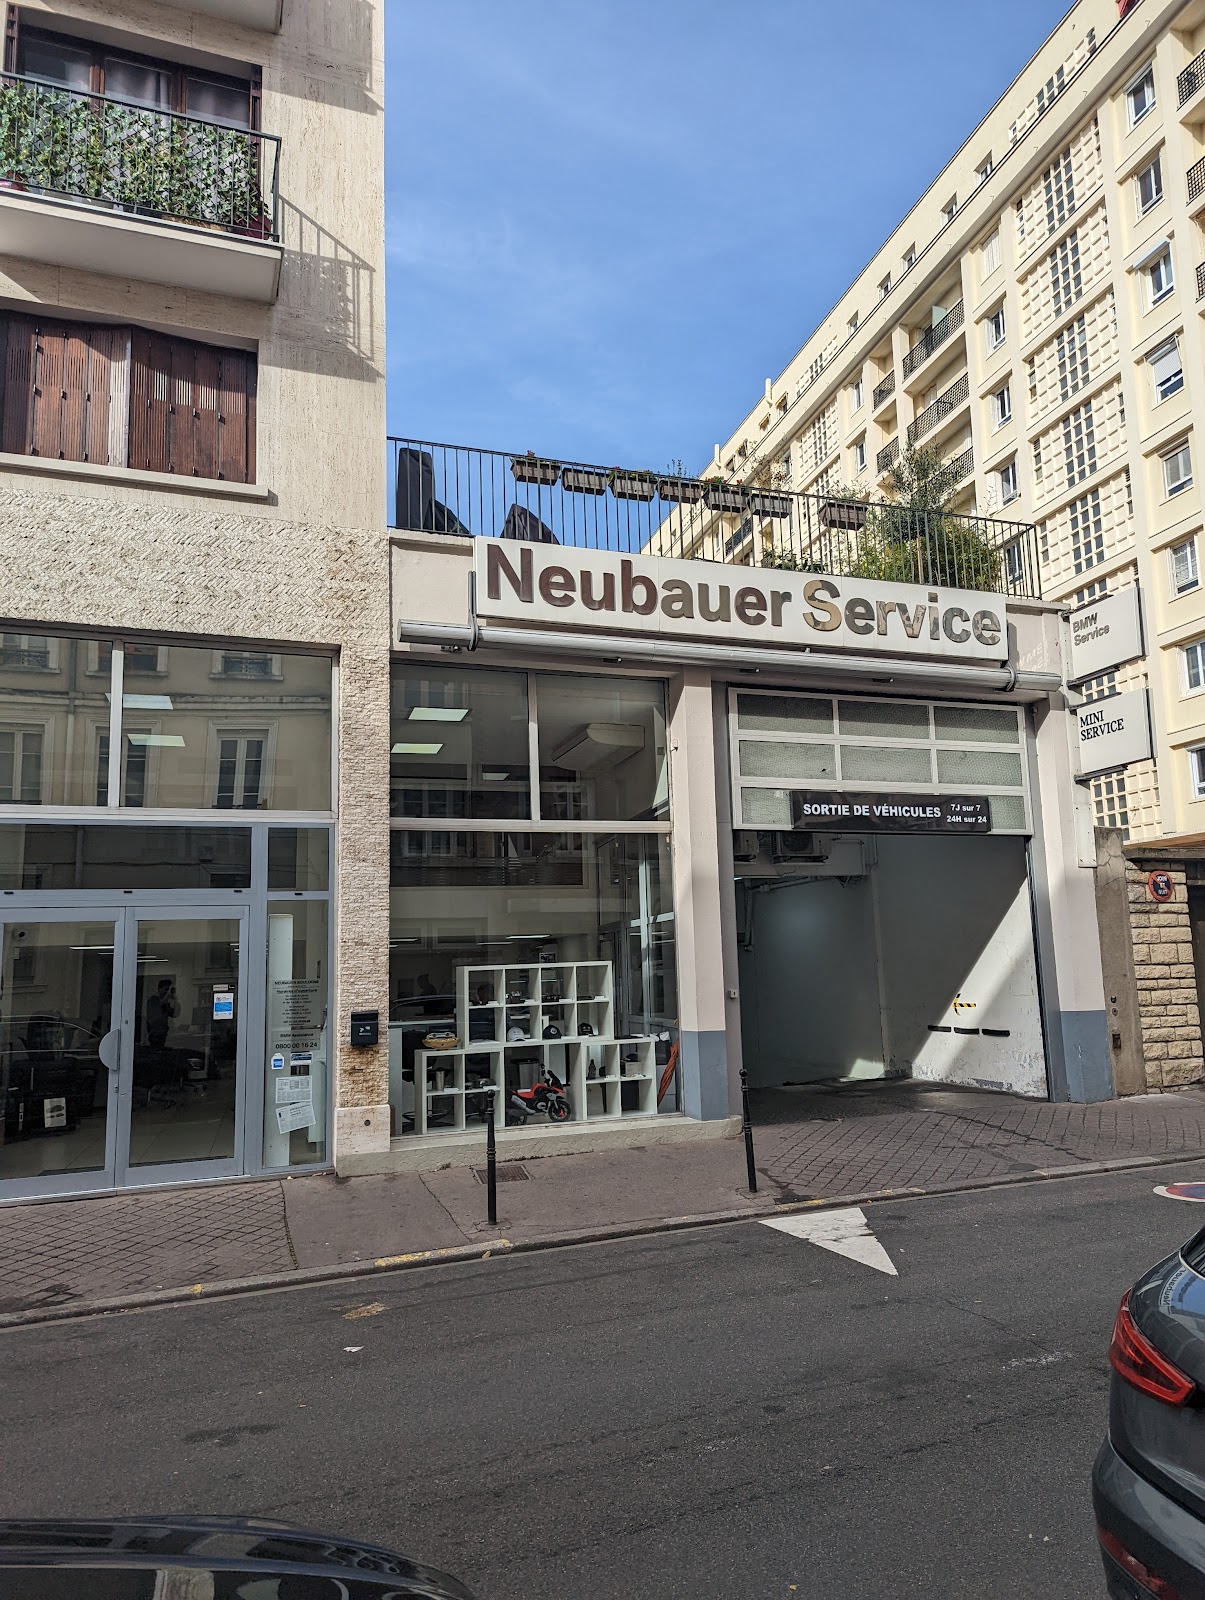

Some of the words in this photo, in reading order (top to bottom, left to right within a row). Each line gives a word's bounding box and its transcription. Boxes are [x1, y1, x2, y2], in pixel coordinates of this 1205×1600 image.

[486, 544, 792, 627] Neubauer
[802, 579, 1002, 646] Service
[1073, 612, 1098, 633] BMW
[1074, 624, 1110, 646] Service
[1080, 710, 1104, 728] MINI
[1081, 718, 1124, 741] SERVICE
[803, 803, 850, 816] SORTIE
[853, 805, 870, 816] DE
[874, 803, 941, 818] VÉHICULES
[950, 803, 961, 812] 7J
[976, 804, 981, 812] 7
[946, 815, 962, 823] 24H
[978, 816, 987, 824] 24
